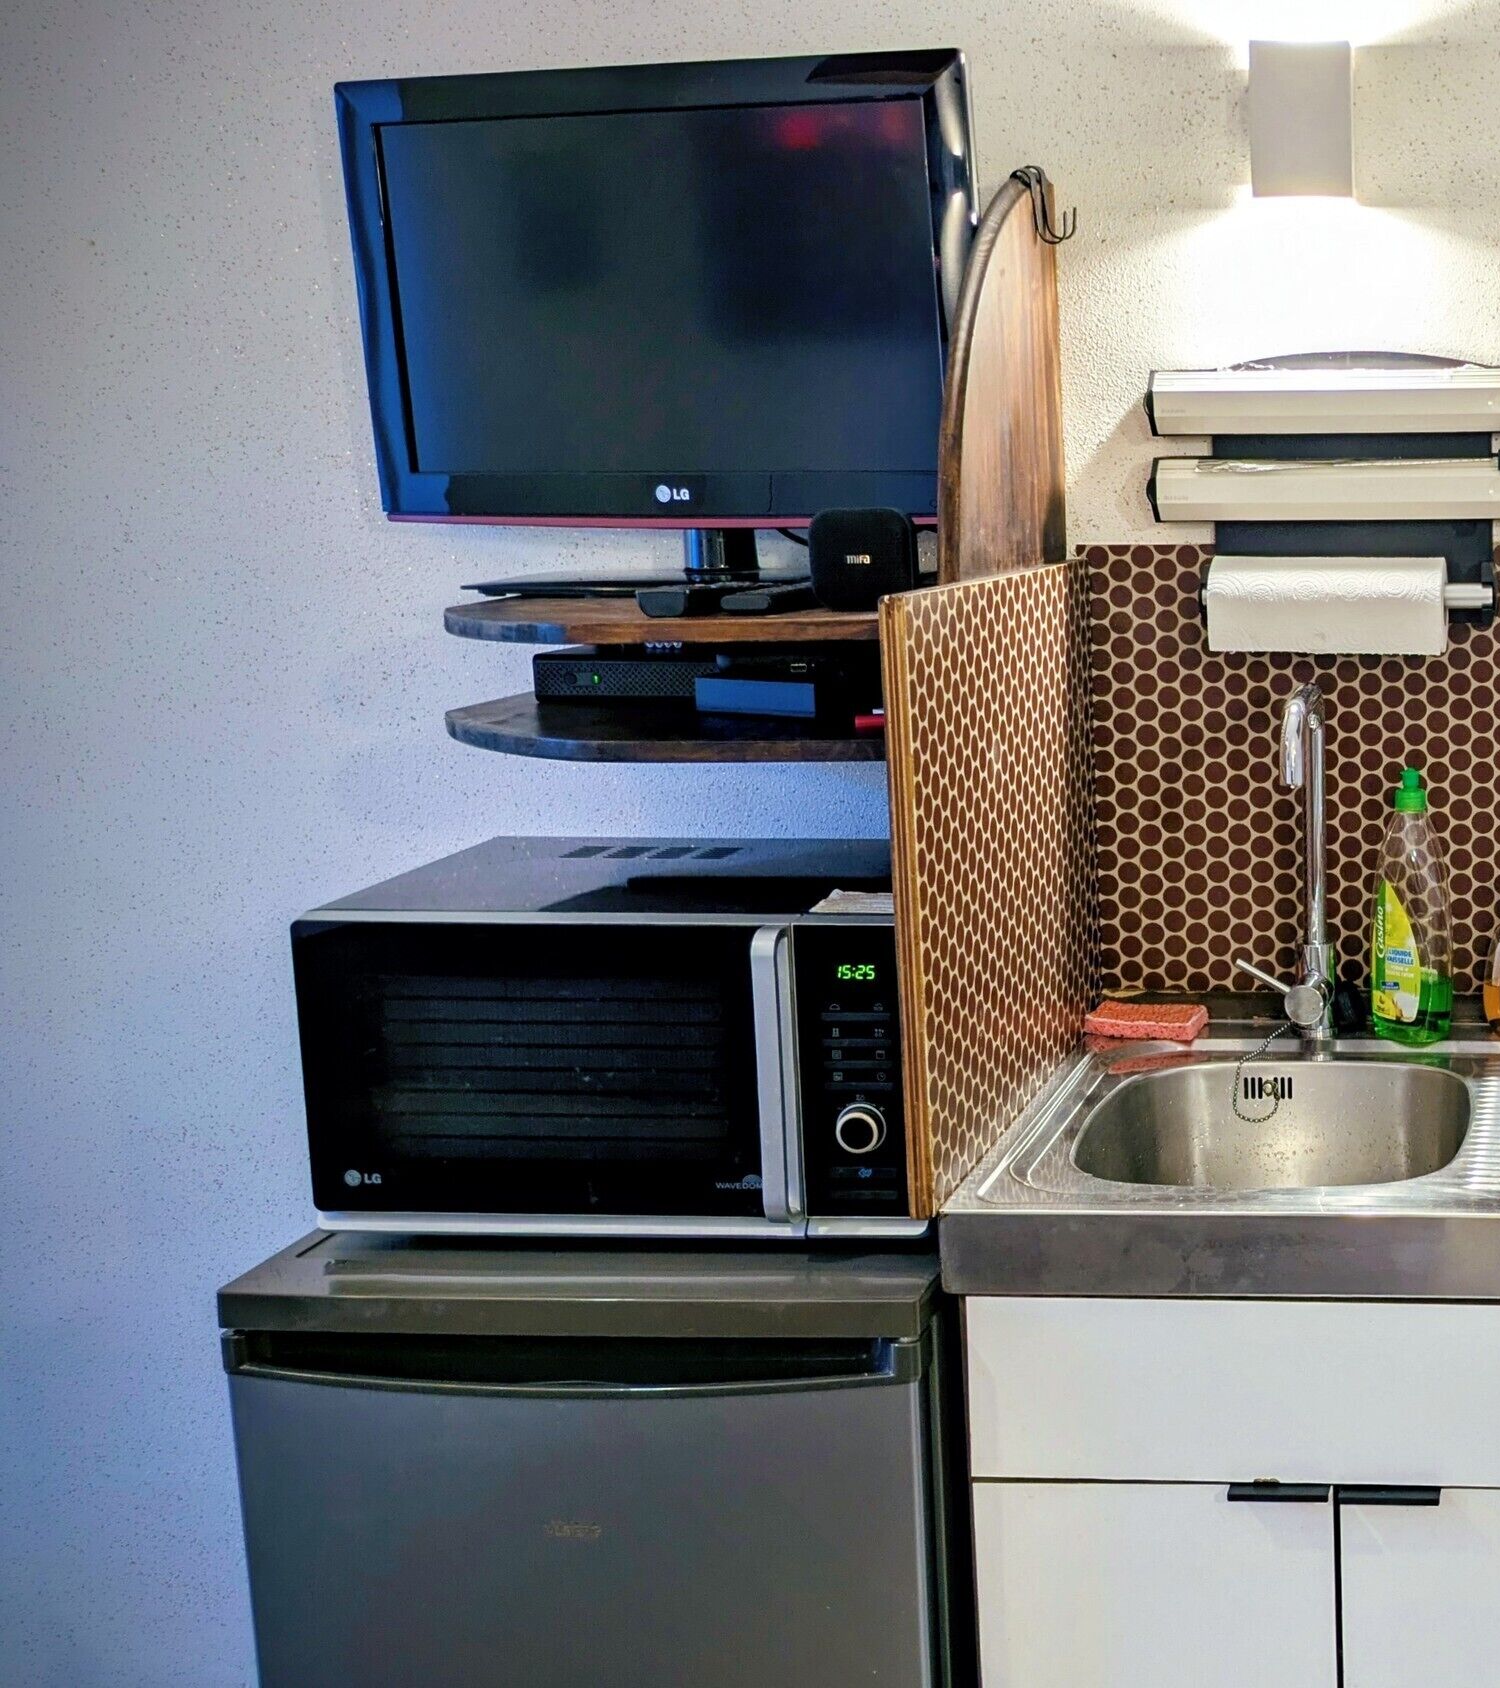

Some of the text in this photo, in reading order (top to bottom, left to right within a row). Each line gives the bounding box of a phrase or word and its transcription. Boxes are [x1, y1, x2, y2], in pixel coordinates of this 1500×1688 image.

[672, 487, 690, 501] LG
[1376, 906, 1385, 958] Casino
[837, 964, 876, 980] 15:25
[363, 1172, 382, 1184] LG
[715, 1181, 763, 1190] WAVEDOM
